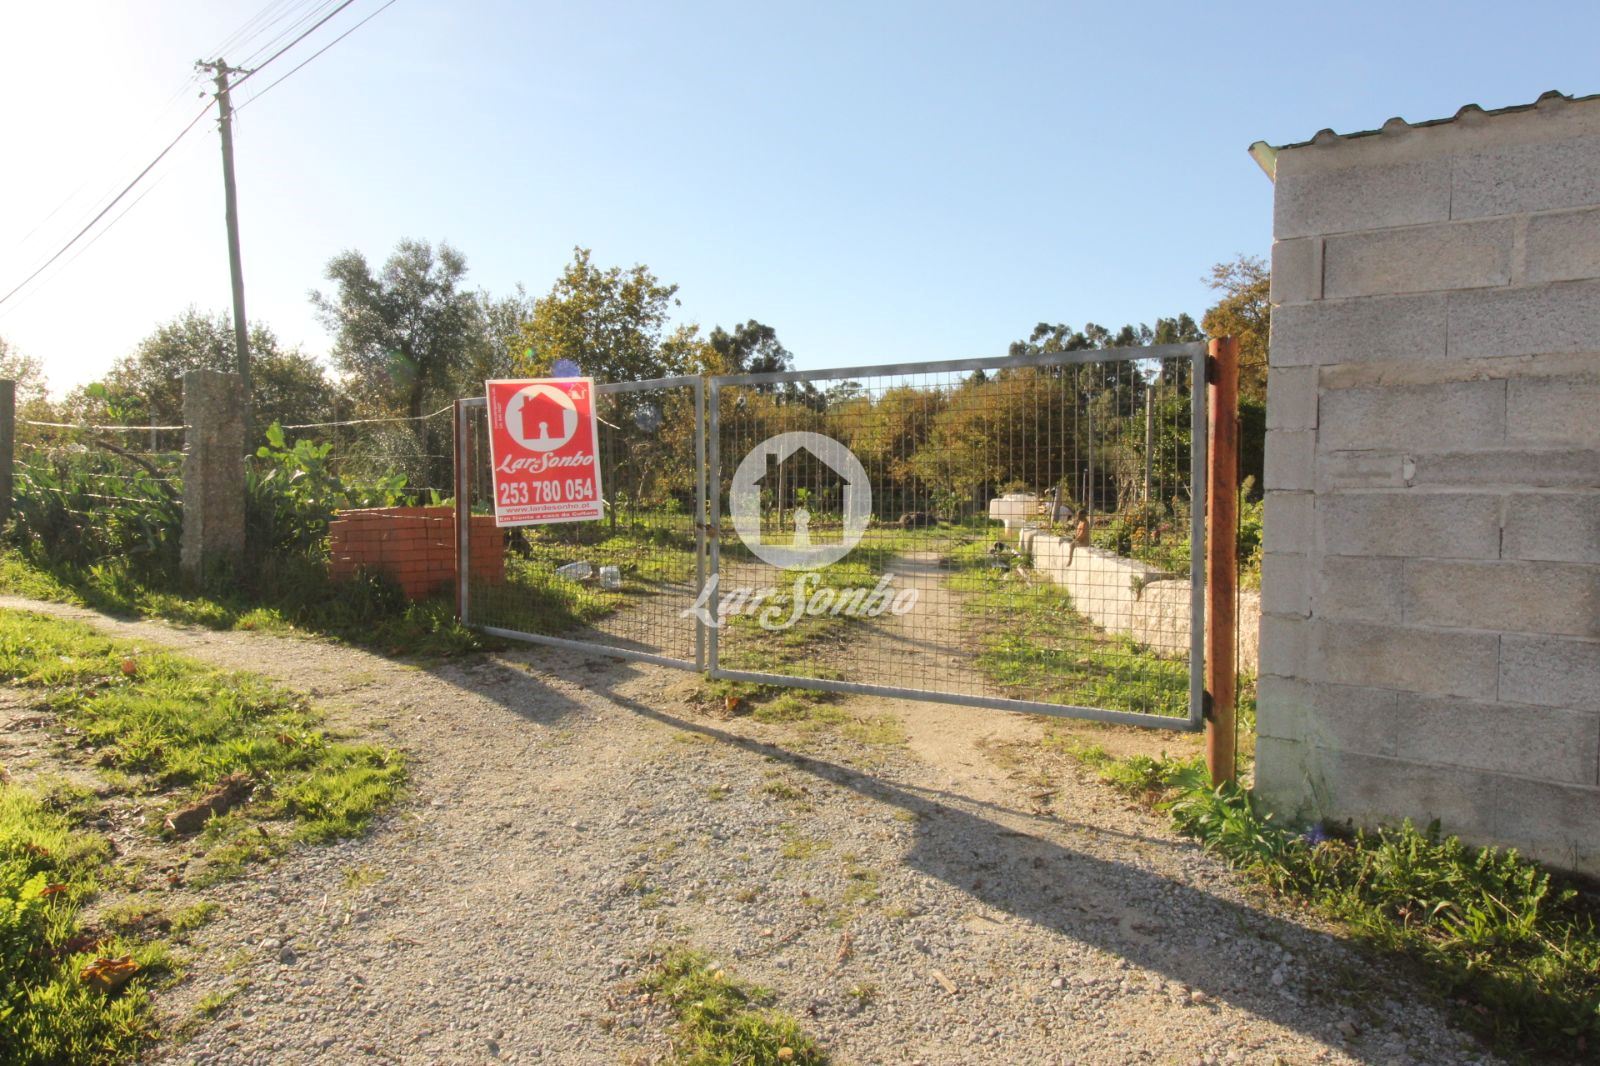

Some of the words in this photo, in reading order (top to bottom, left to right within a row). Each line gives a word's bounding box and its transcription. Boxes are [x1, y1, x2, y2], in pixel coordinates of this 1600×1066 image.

[500, 482, 529, 504] 253
[532, 480, 561, 502] 780
[565, 478, 593, 500] 054
